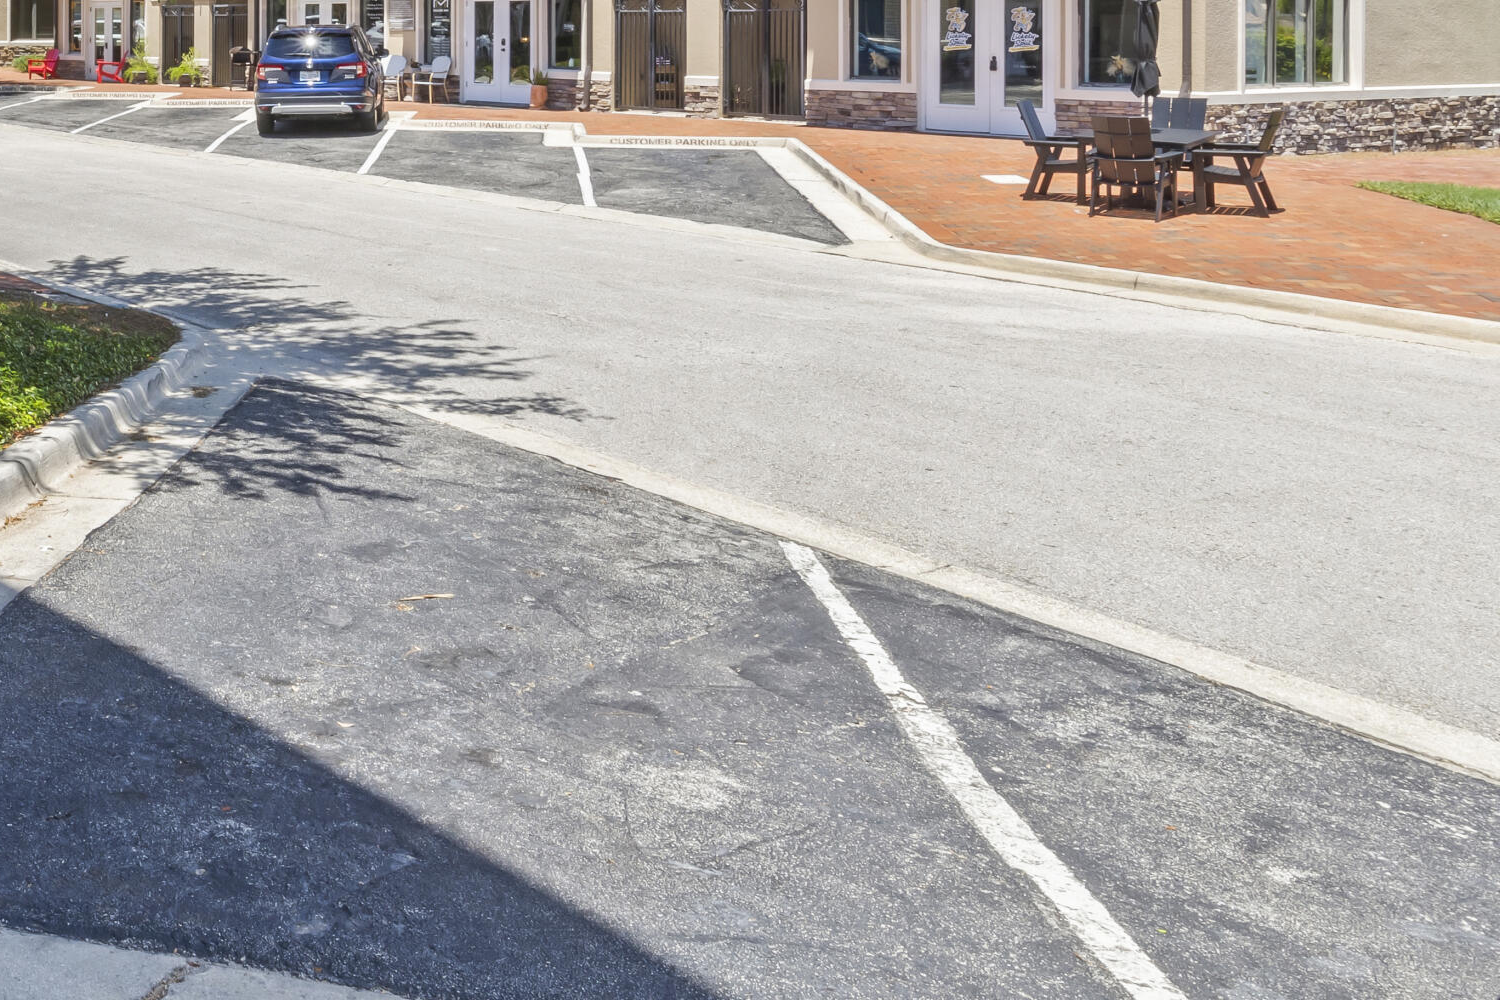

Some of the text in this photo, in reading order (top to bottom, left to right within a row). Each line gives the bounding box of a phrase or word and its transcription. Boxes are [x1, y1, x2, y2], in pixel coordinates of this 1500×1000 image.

[423, 121, 550, 130] CUSTOMER PARKING ONLY
[609, 137, 758, 148] CUSTOMER PARKING ONLY
